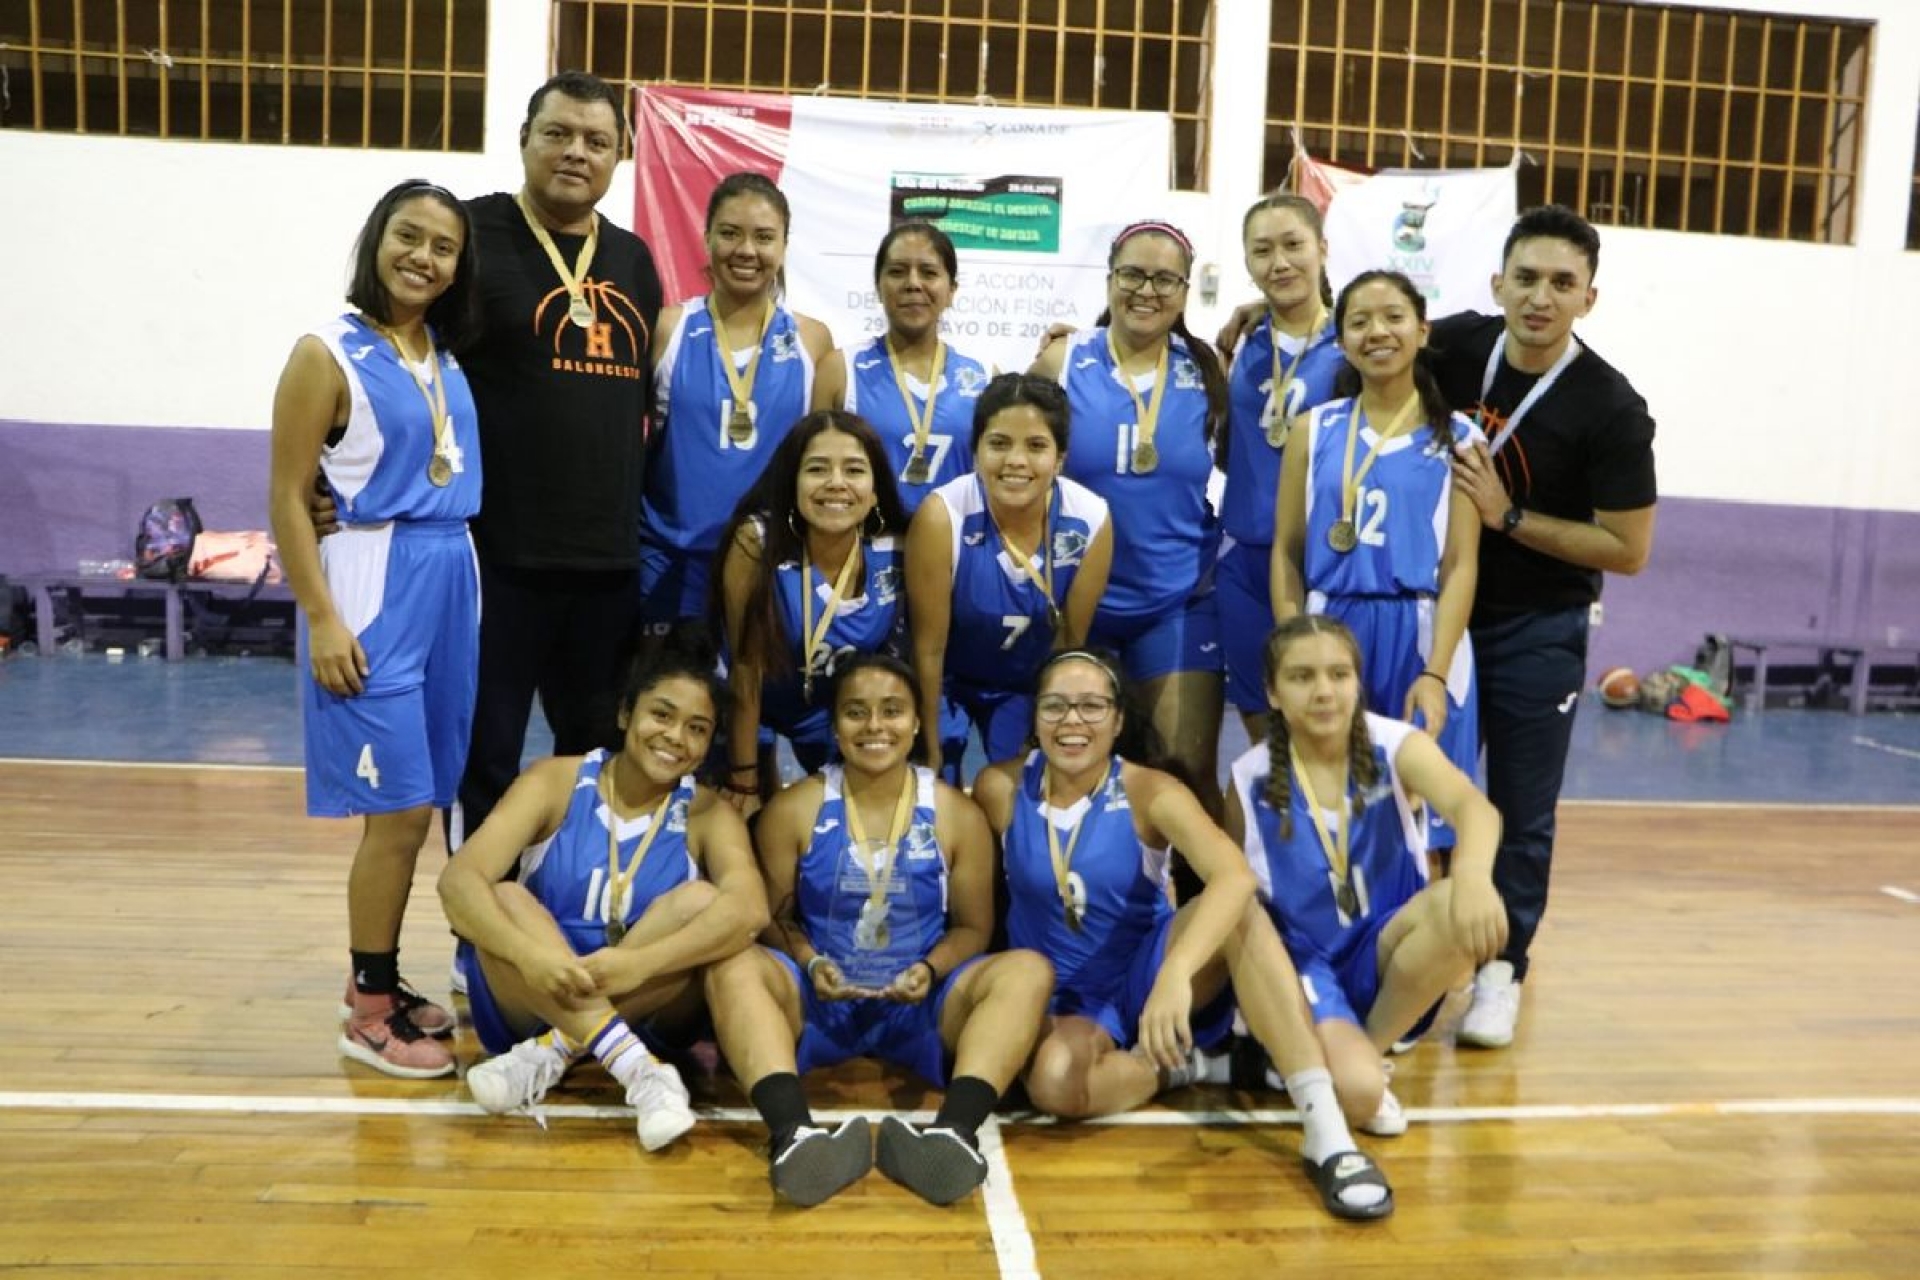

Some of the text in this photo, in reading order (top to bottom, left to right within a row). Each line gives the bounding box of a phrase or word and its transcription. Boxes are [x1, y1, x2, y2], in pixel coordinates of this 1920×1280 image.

[975, 270, 1055, 291] ACCIÓN
[1014, 292, 1078, 318] FÍSICA
[586, 321, 614, 359] H
[940, 321, 980, 338] AYO
[987, 321, 1012, 337] DE
[899, 433, 954, 484] 27
[1354, 486, 1388, 546] 12
[1000, 614, 1031, 650] 7
[356, 743, 379, 790] 4
